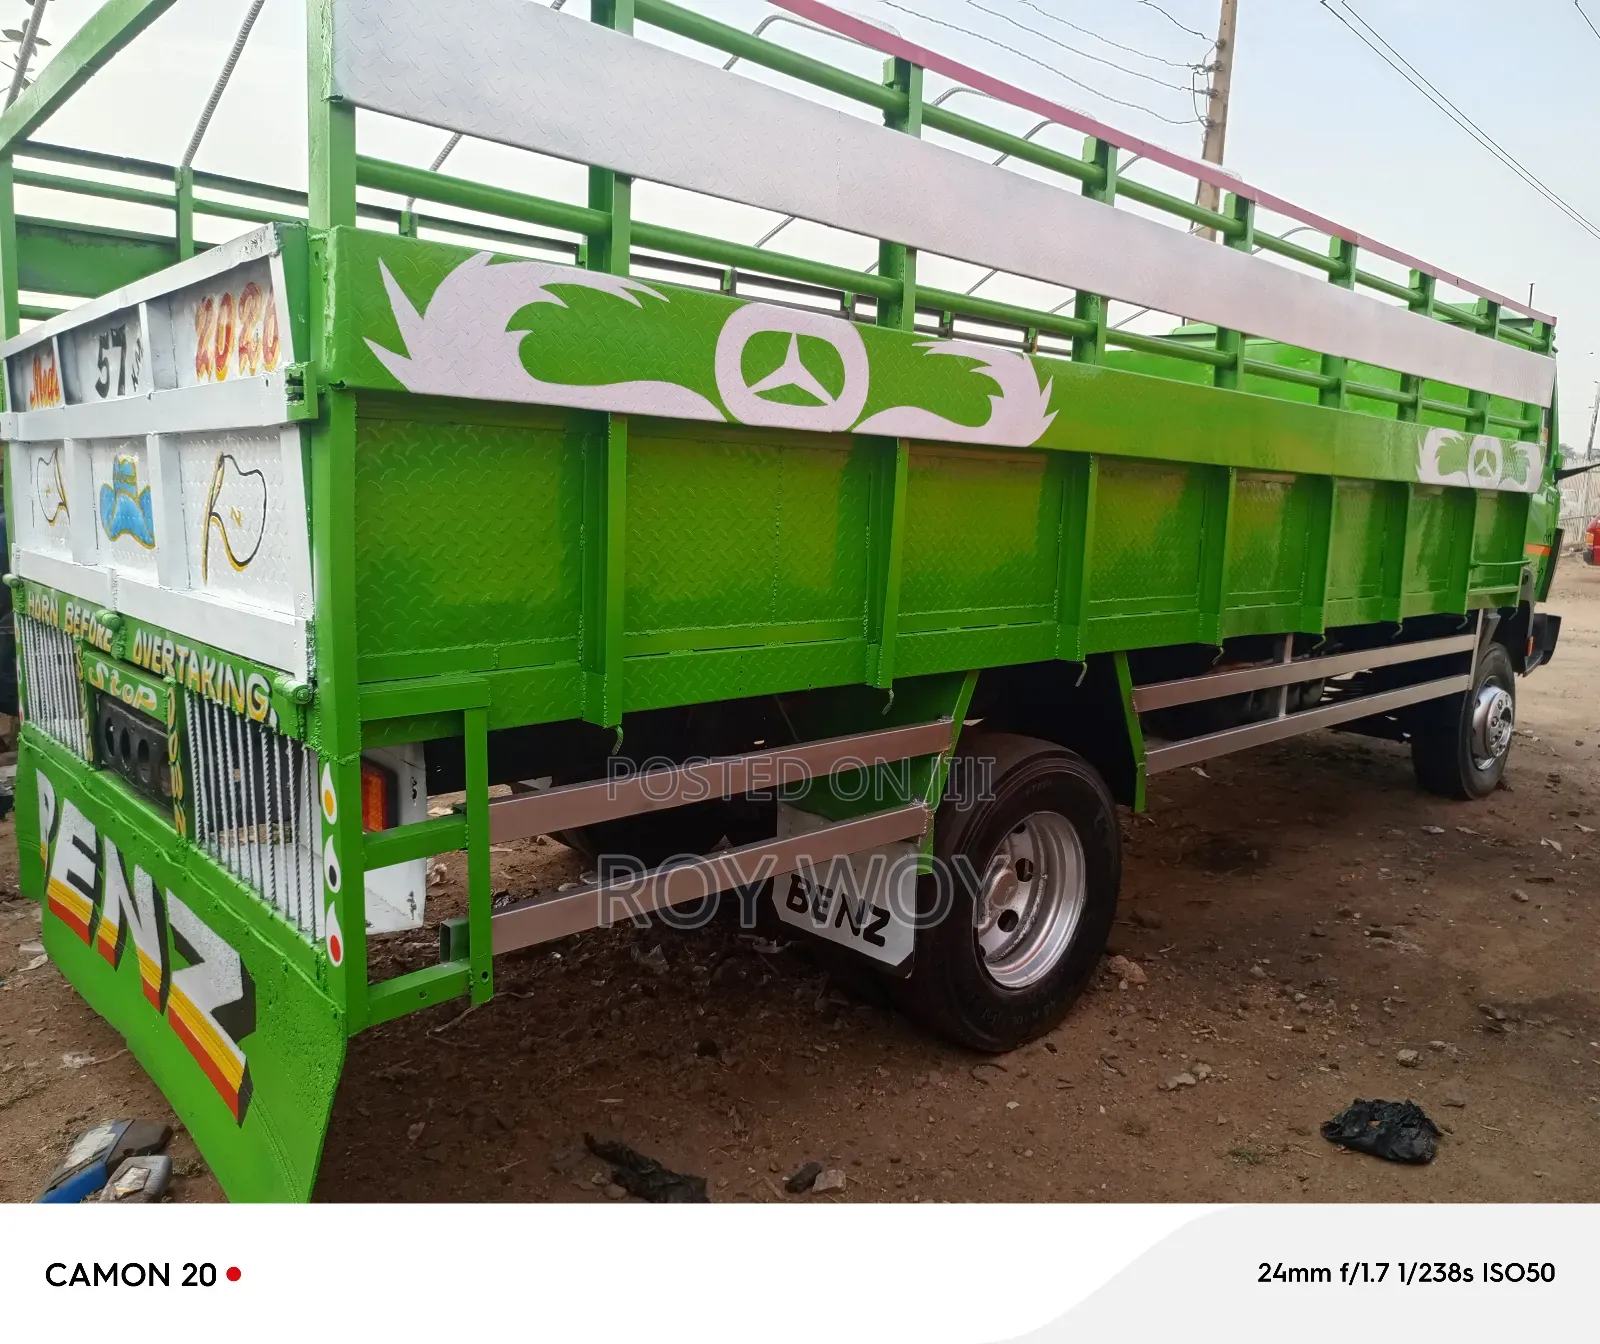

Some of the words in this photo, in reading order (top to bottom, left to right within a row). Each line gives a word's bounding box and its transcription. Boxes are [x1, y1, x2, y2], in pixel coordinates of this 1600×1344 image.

[95, 324, 126, 398] 57
[28, 591, 60, 627] HORN
[785, 873, 892, 948] BENZ
